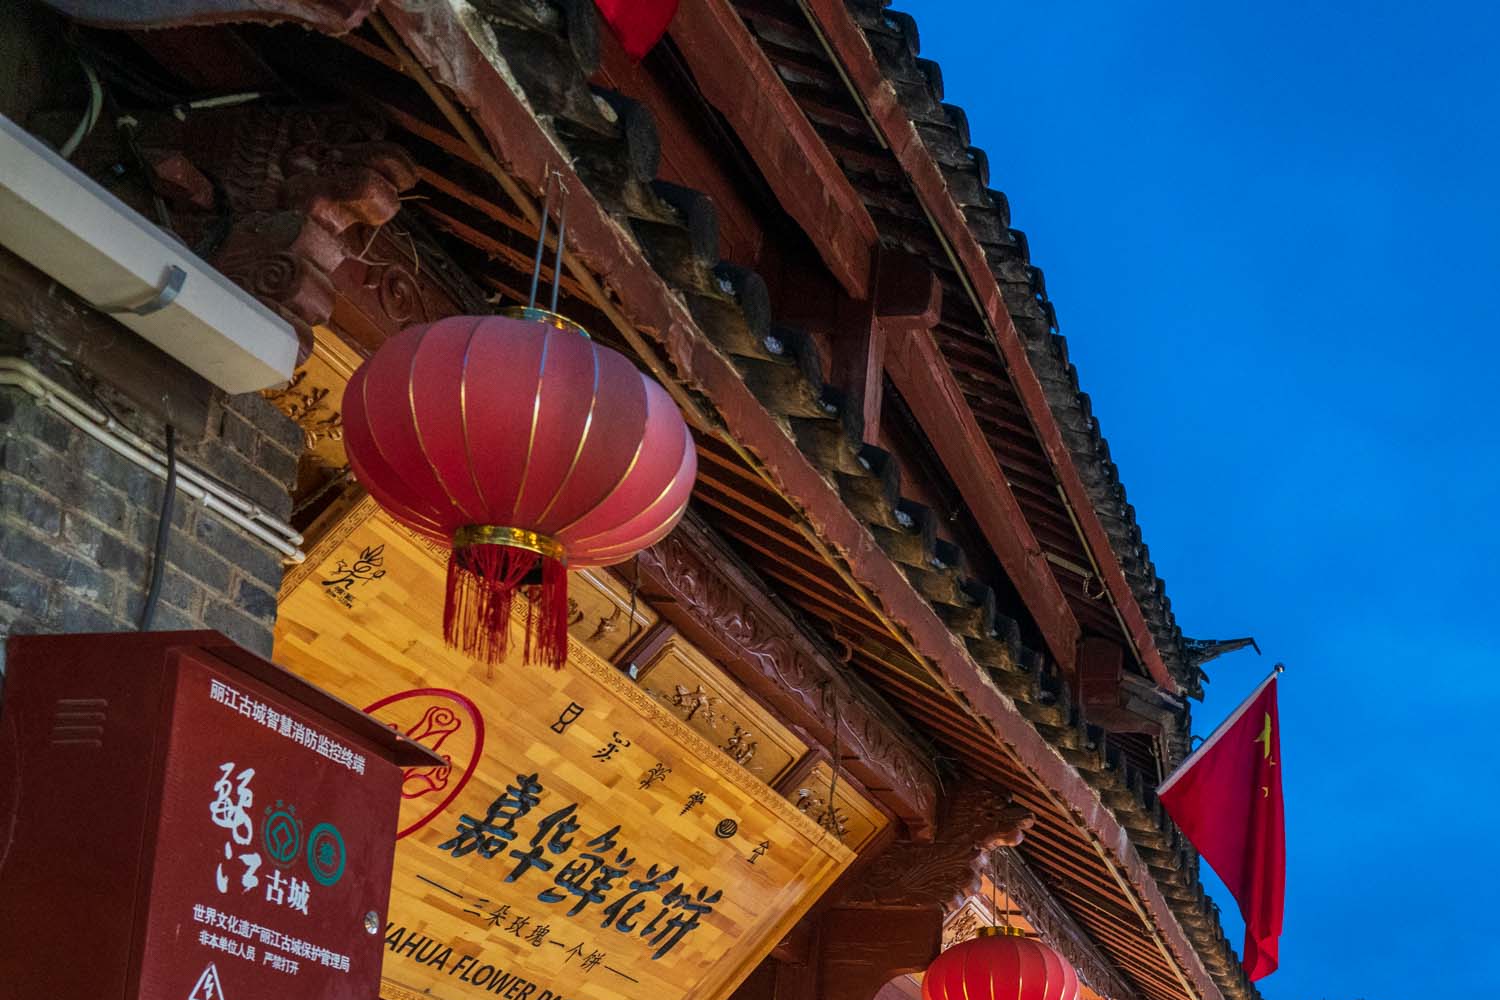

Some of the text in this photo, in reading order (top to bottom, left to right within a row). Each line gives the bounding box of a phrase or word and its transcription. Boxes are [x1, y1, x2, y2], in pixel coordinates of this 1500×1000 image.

[210, 678, 366, 776] 丽江古城智慧消防监控终端
[265, 869, 311, 916] 古城
[438, 773, 723, 960] 嘉华鲜花饼
[193, 903, 350, 973] 世界文化遗产丽江古城保护管理局
[198, 930, 300, 976] 非本单位人员 严禁打开
[463, 899, 605, 973] 三朵玫瑰一个饼
